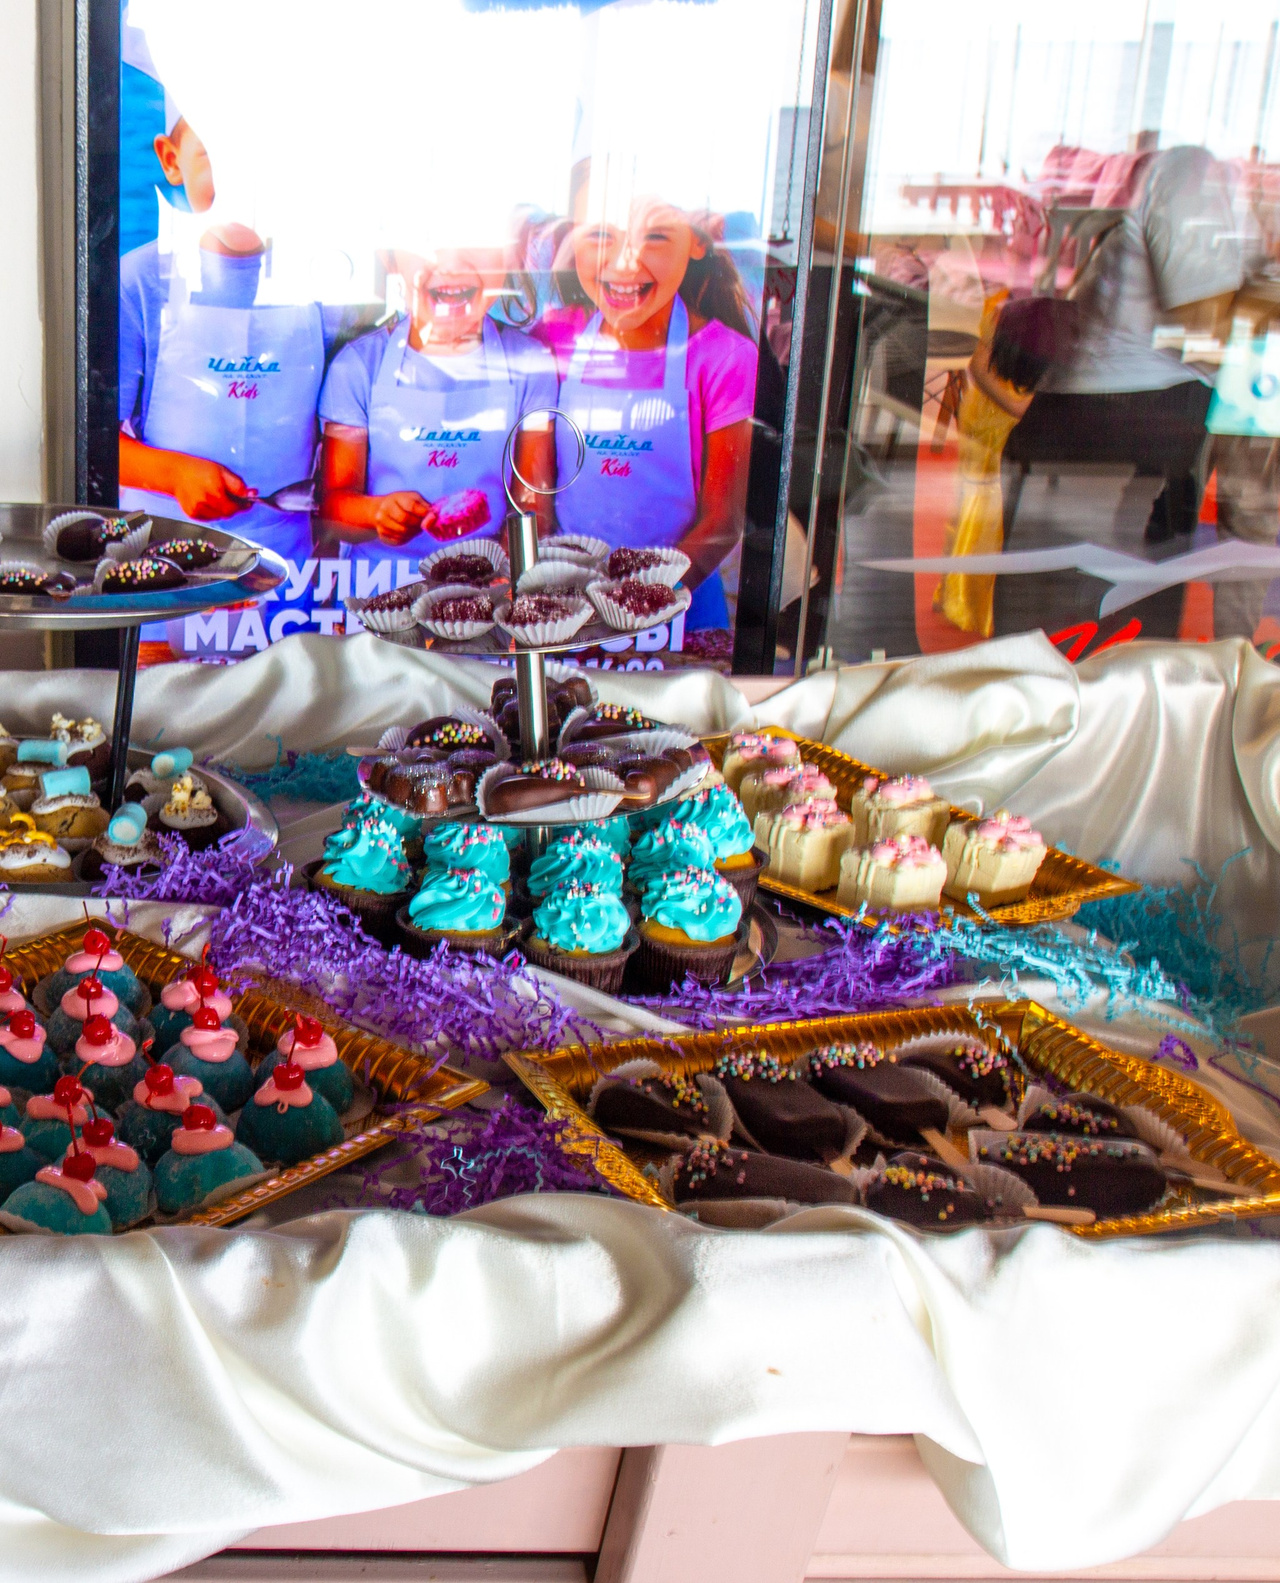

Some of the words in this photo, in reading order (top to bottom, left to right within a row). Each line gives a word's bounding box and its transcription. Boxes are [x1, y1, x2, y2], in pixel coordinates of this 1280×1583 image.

[208, 356, 281, 372] Чайка
[228, 381, 259, 400] Kids
[585, 434, 654, 451] Чайка
[428, 450, 459, 468] Kids
[600, 458, 632, 477] Kids
[184, 608, 368, 652] МАСТ
